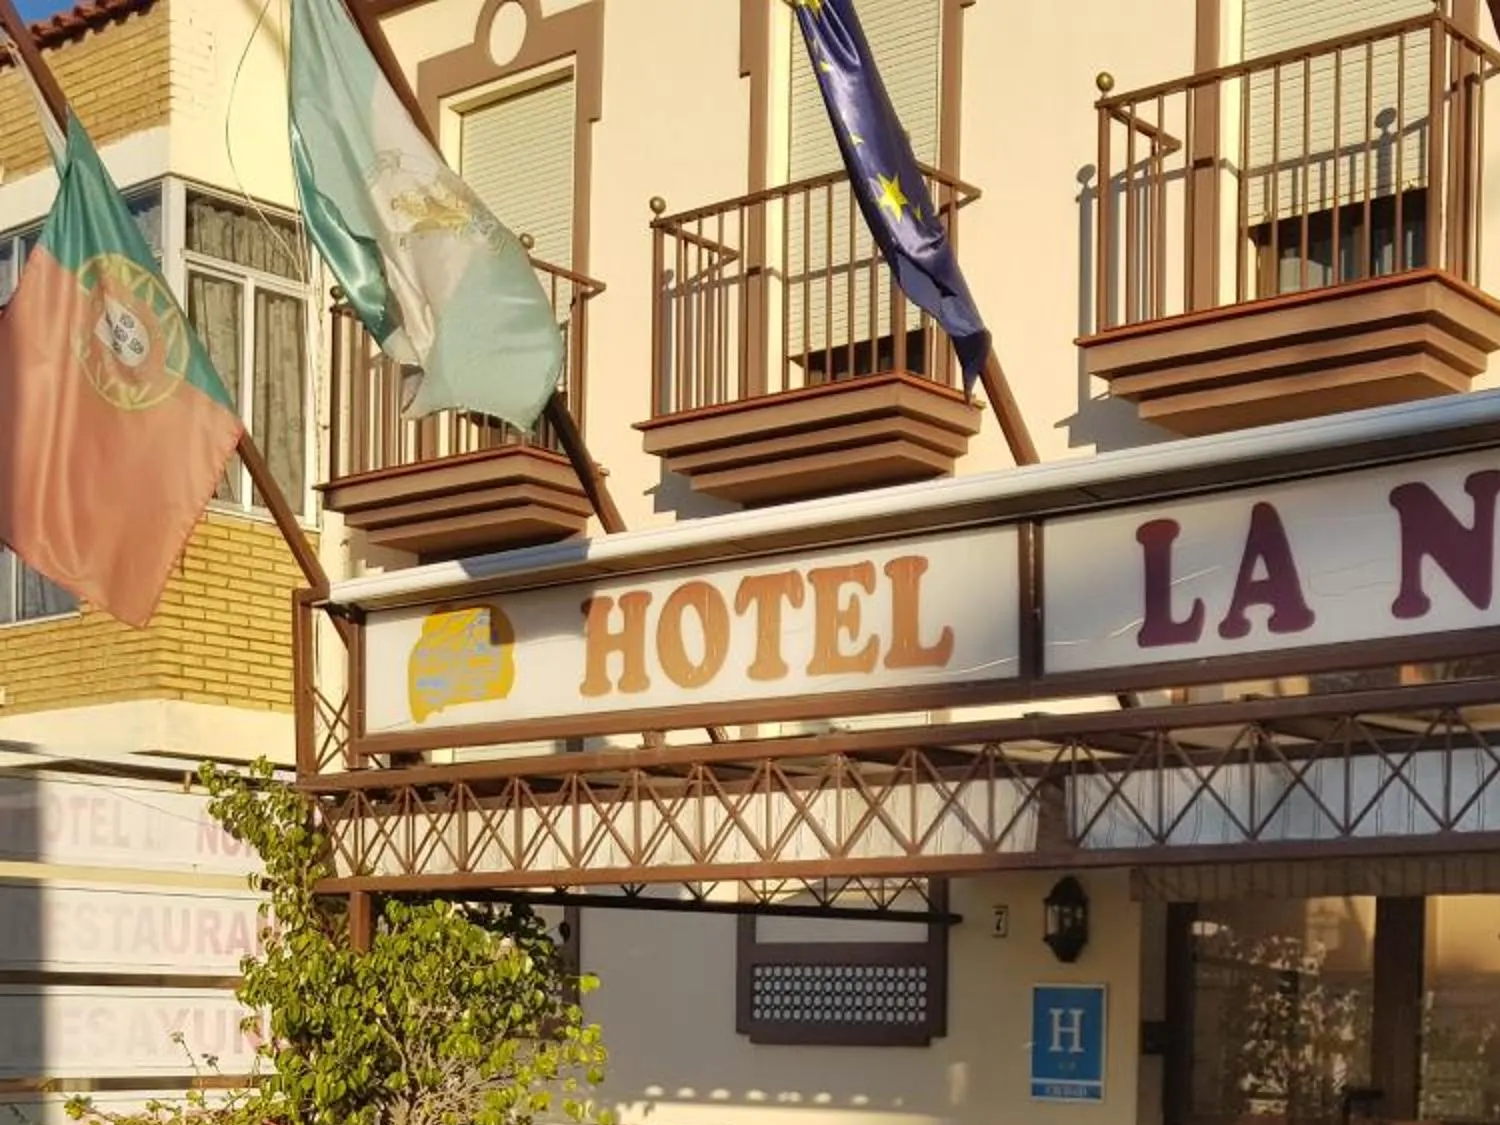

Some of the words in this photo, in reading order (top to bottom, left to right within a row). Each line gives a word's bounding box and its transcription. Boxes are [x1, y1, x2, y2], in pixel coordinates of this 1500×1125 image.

[580, 555, 954, 696] HOTEL
[1136, 500, 1315, 648] LA
[1049, 1008, 1085, 1053] H
